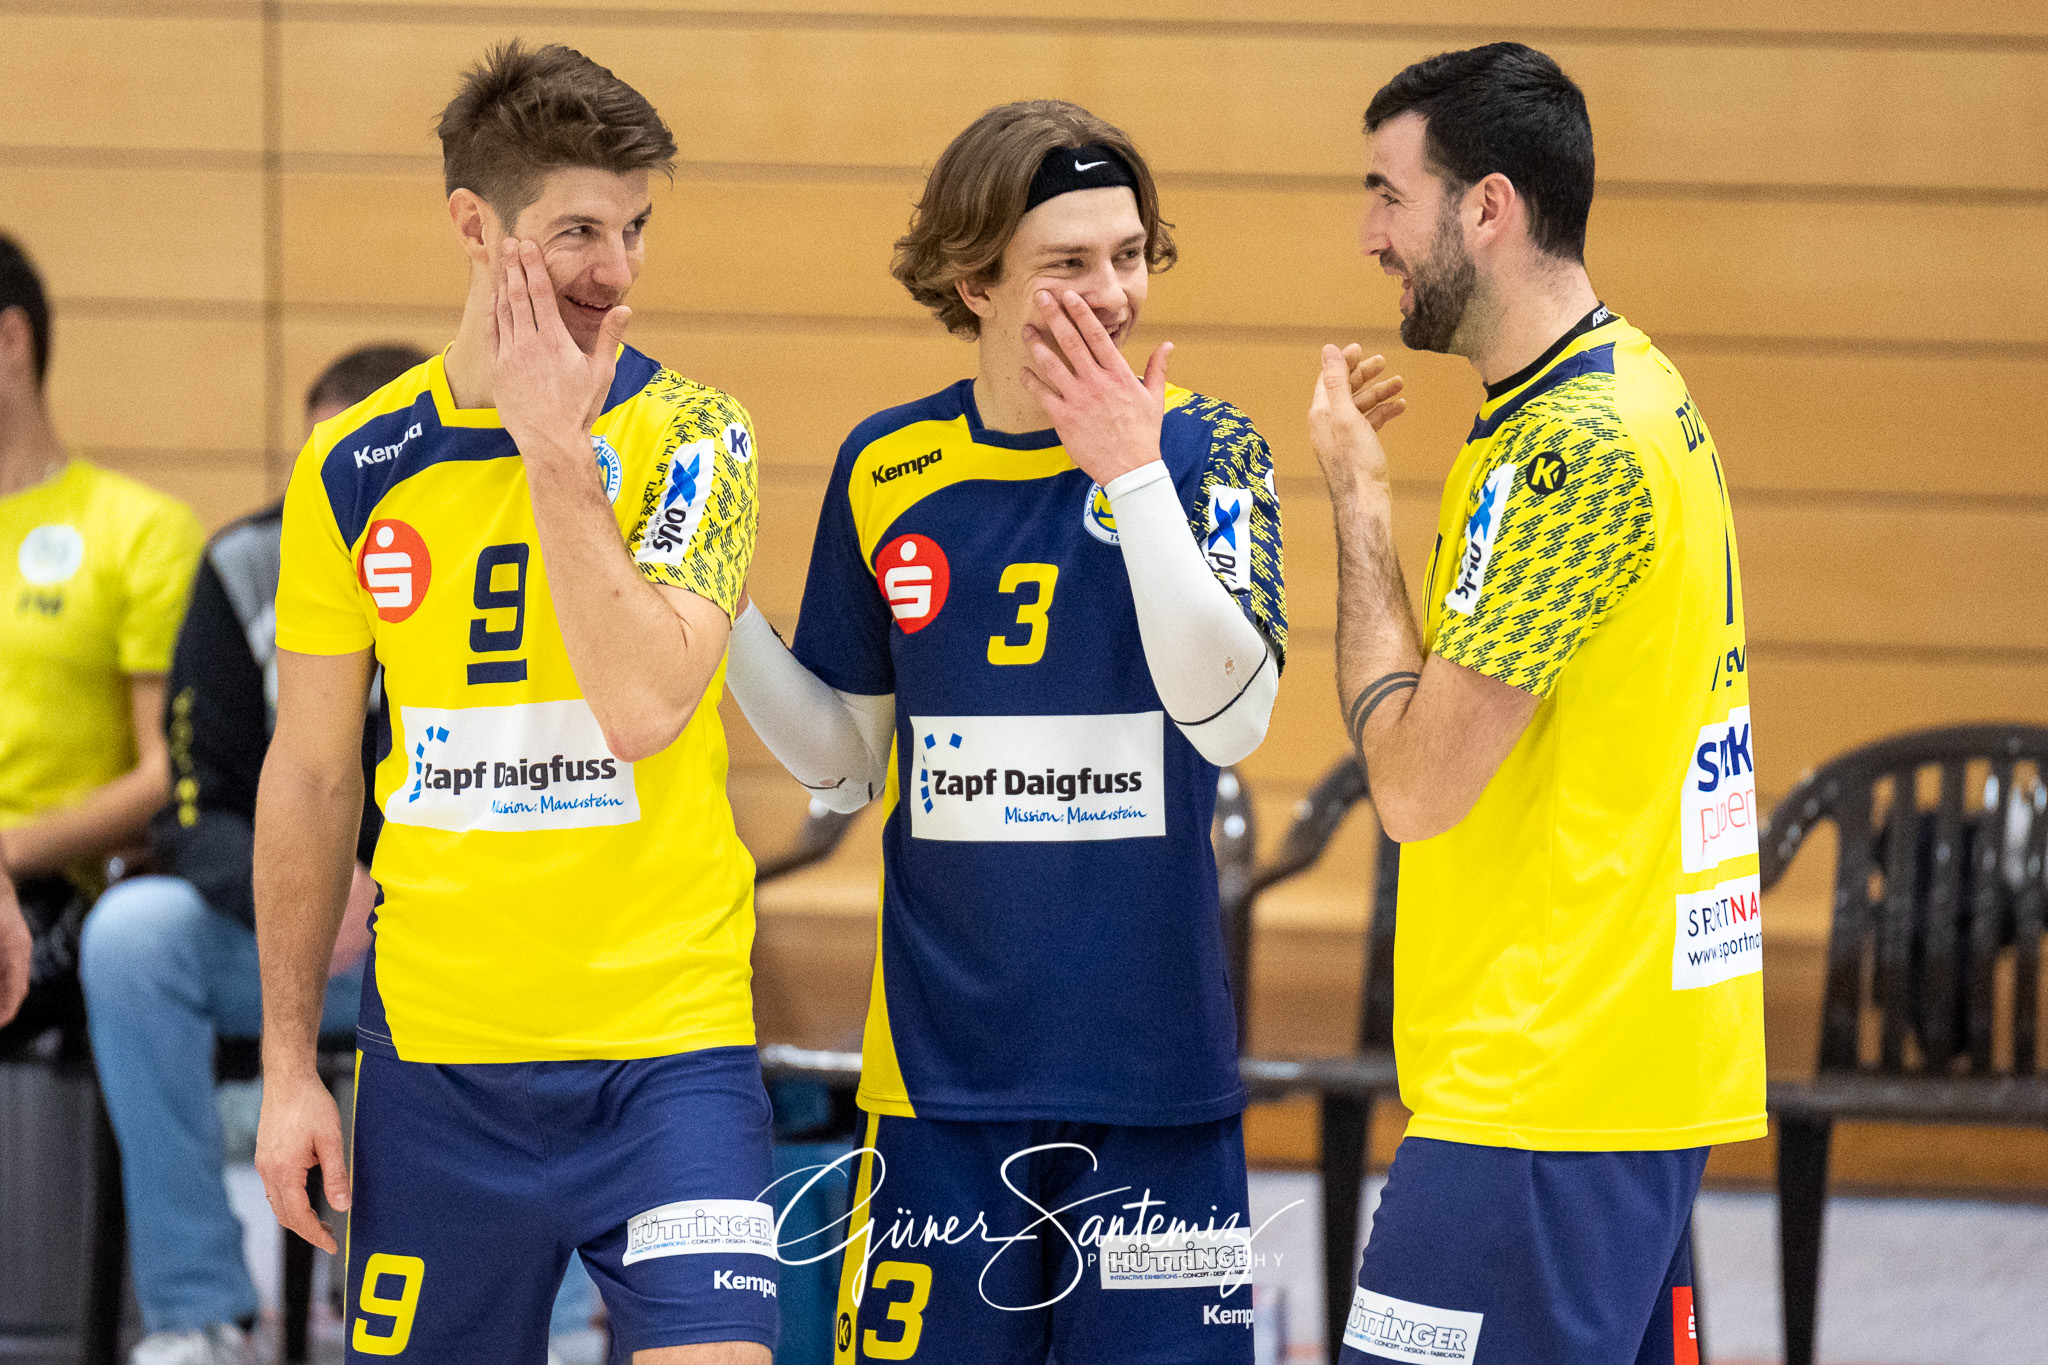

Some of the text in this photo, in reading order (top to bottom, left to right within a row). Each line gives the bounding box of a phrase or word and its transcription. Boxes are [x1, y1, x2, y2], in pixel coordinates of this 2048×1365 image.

[871, 448, 942, 487] Kempa
[469, 542, 529, 653] 9
[987, 563, 1059, 665] 3
[425, 755, 617, 796] Zapf Daigfuss
[932, 767, 1142, 802] Zapf Daigfuss
[1005, 806, 1064, 825] Mission:
[1688, 889, 1761, 937] SPORTNA
[1182, 1271, 1209, 1279] CONCEPT
[352, 1252, 425, 1356] 9
[863, 1261, 932, 1361] 3
[1203, 1304, 1254, 1329] Kemp
[1374, 1339, 1465, 1360] CONCEPT DESIGN FABRICATION
